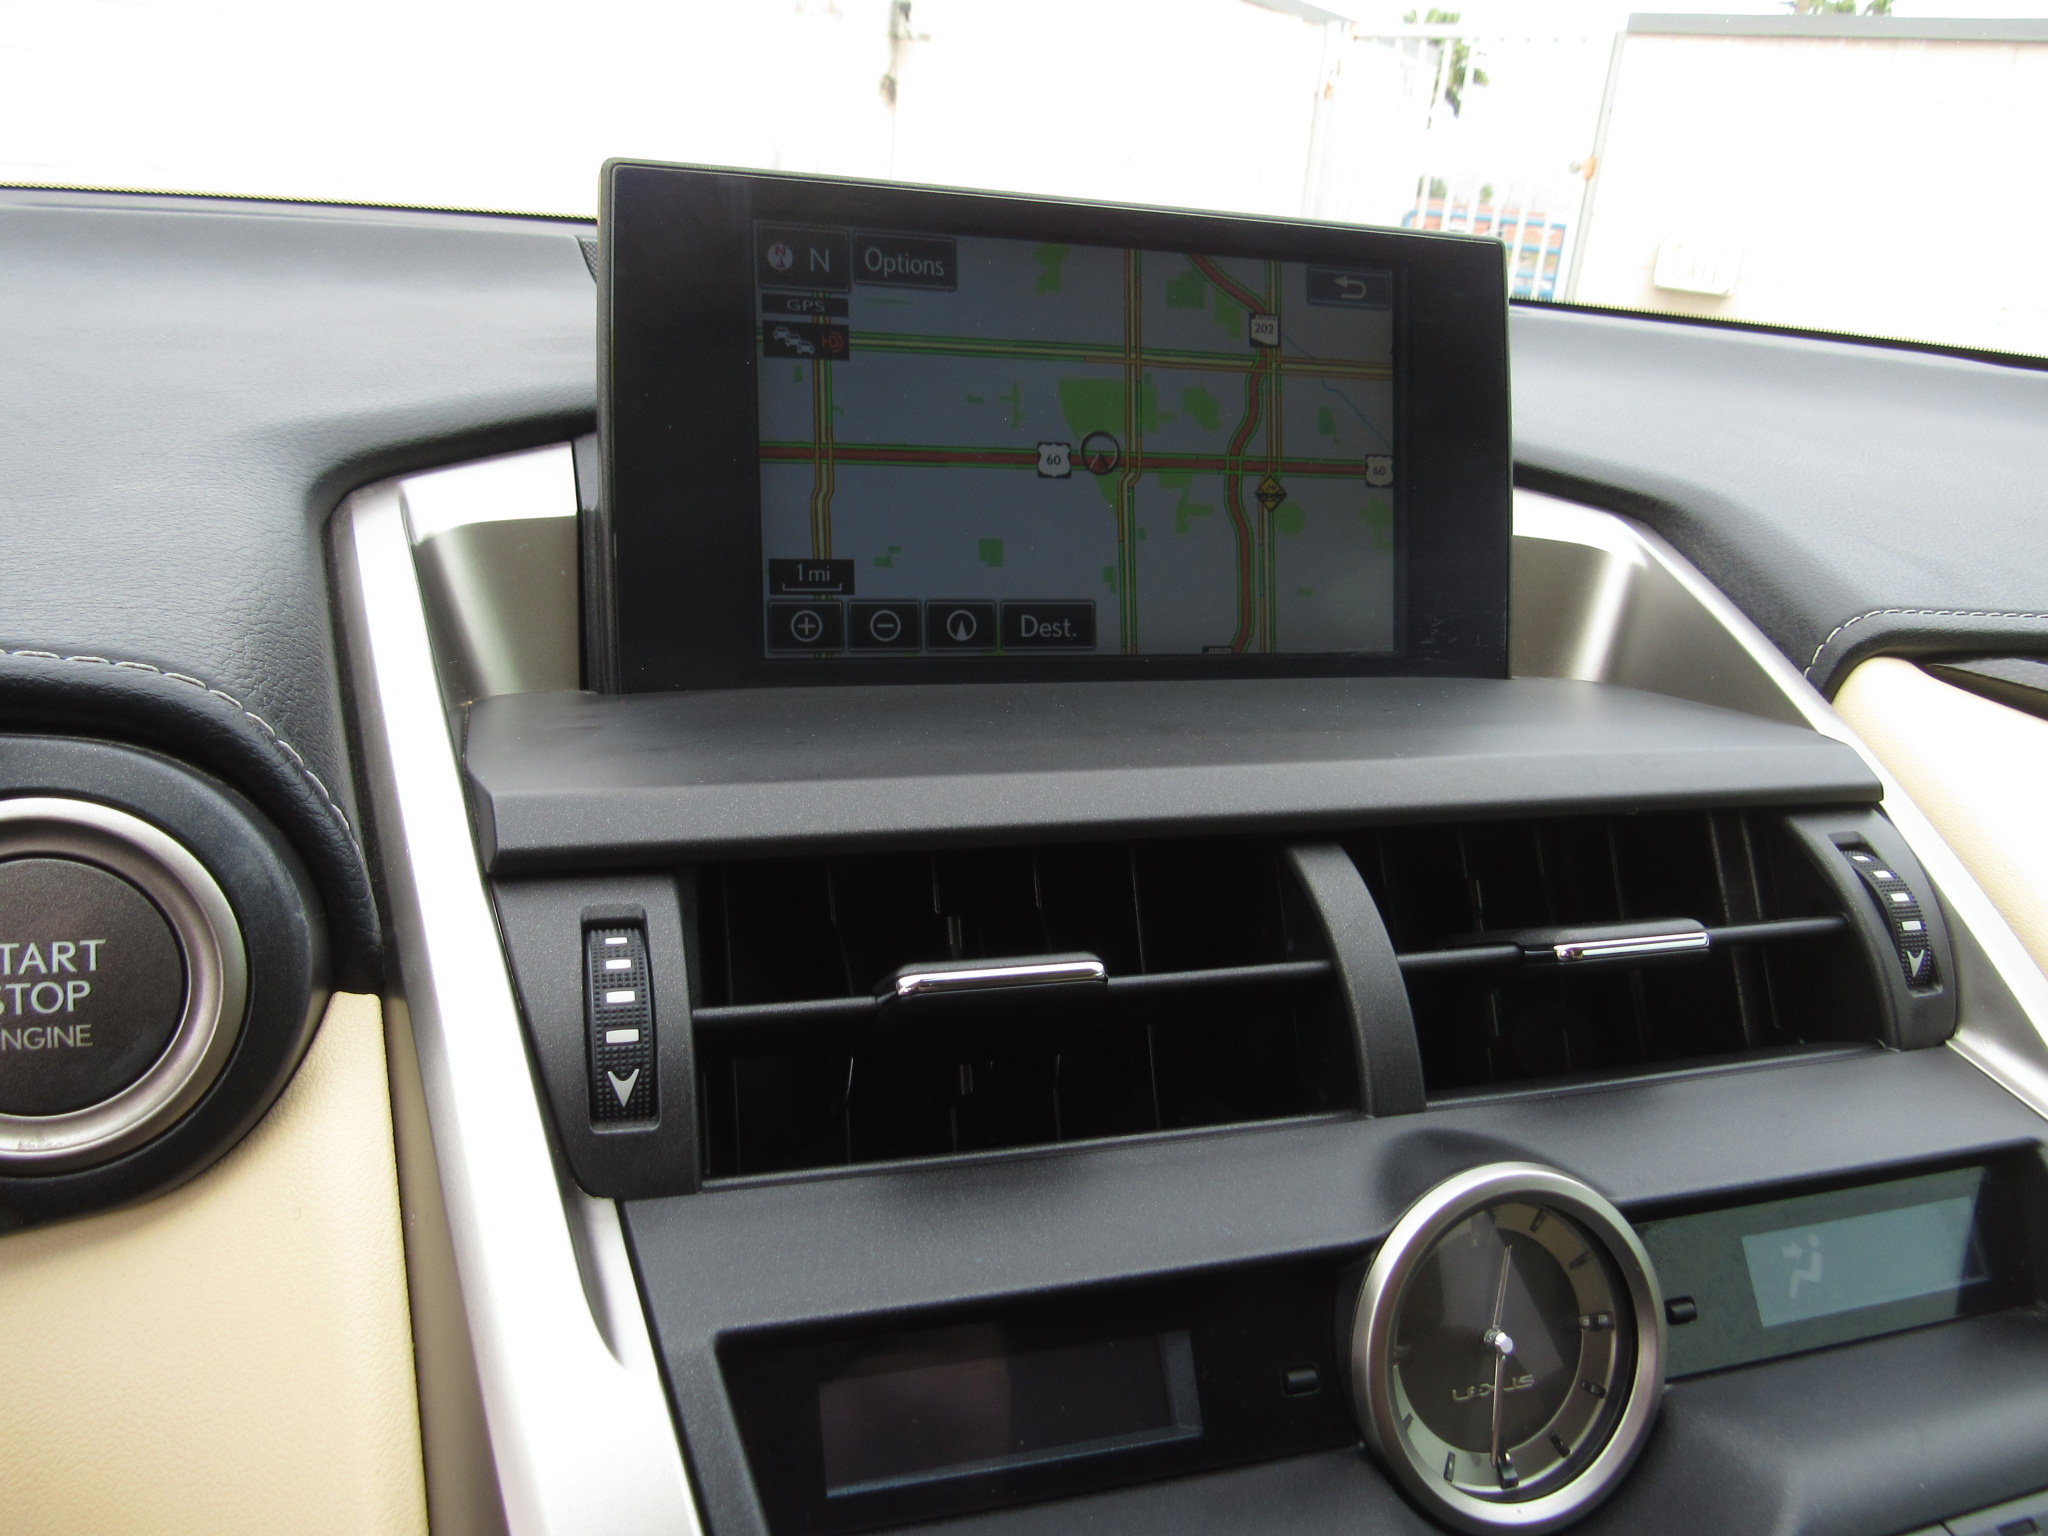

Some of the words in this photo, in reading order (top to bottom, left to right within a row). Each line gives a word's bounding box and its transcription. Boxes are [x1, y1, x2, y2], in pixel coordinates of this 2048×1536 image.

[809, 248, 831, 272] N
[864, 247, 945, 278] Options
[786, 299, 825, 313] GPS
[1254, 323, 1274, 335] 202
[1046, 454, 1062, 466] 60
[1373, 465, 1386, 477] 60
[808, 564, 831, 582] mi
[1020, 614, 1077, 638] Dest.
[0, 939, 107, 975] TART
[0, 1024, 93, 1050] NGINE
